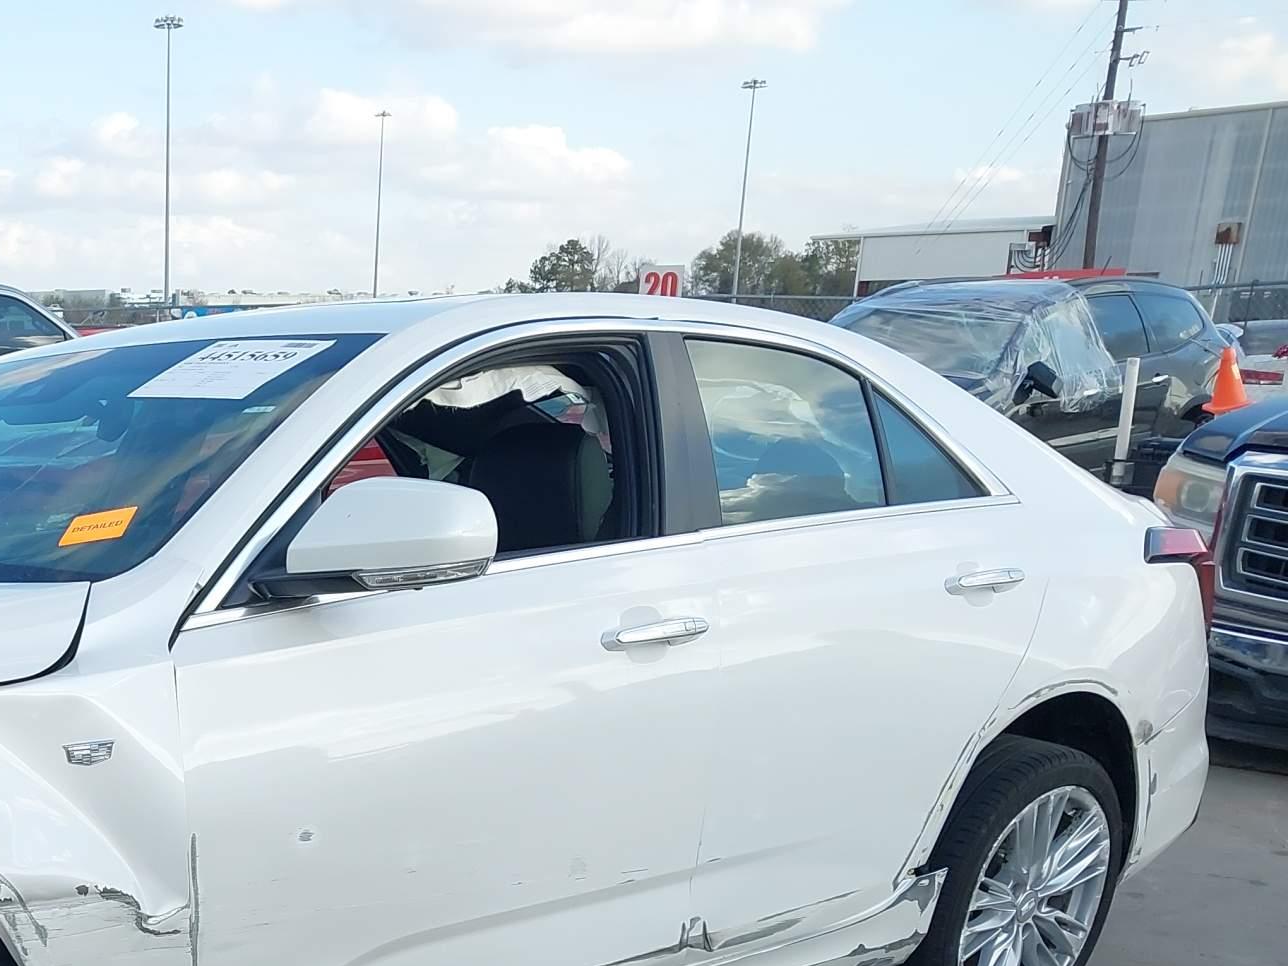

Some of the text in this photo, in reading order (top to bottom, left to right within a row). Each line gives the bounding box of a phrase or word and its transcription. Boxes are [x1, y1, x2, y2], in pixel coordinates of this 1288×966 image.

[644, 271, 678, 297] 20
[198, 351, 298, 362] 44515659
[72, 519, 123, 533] DETAILED
